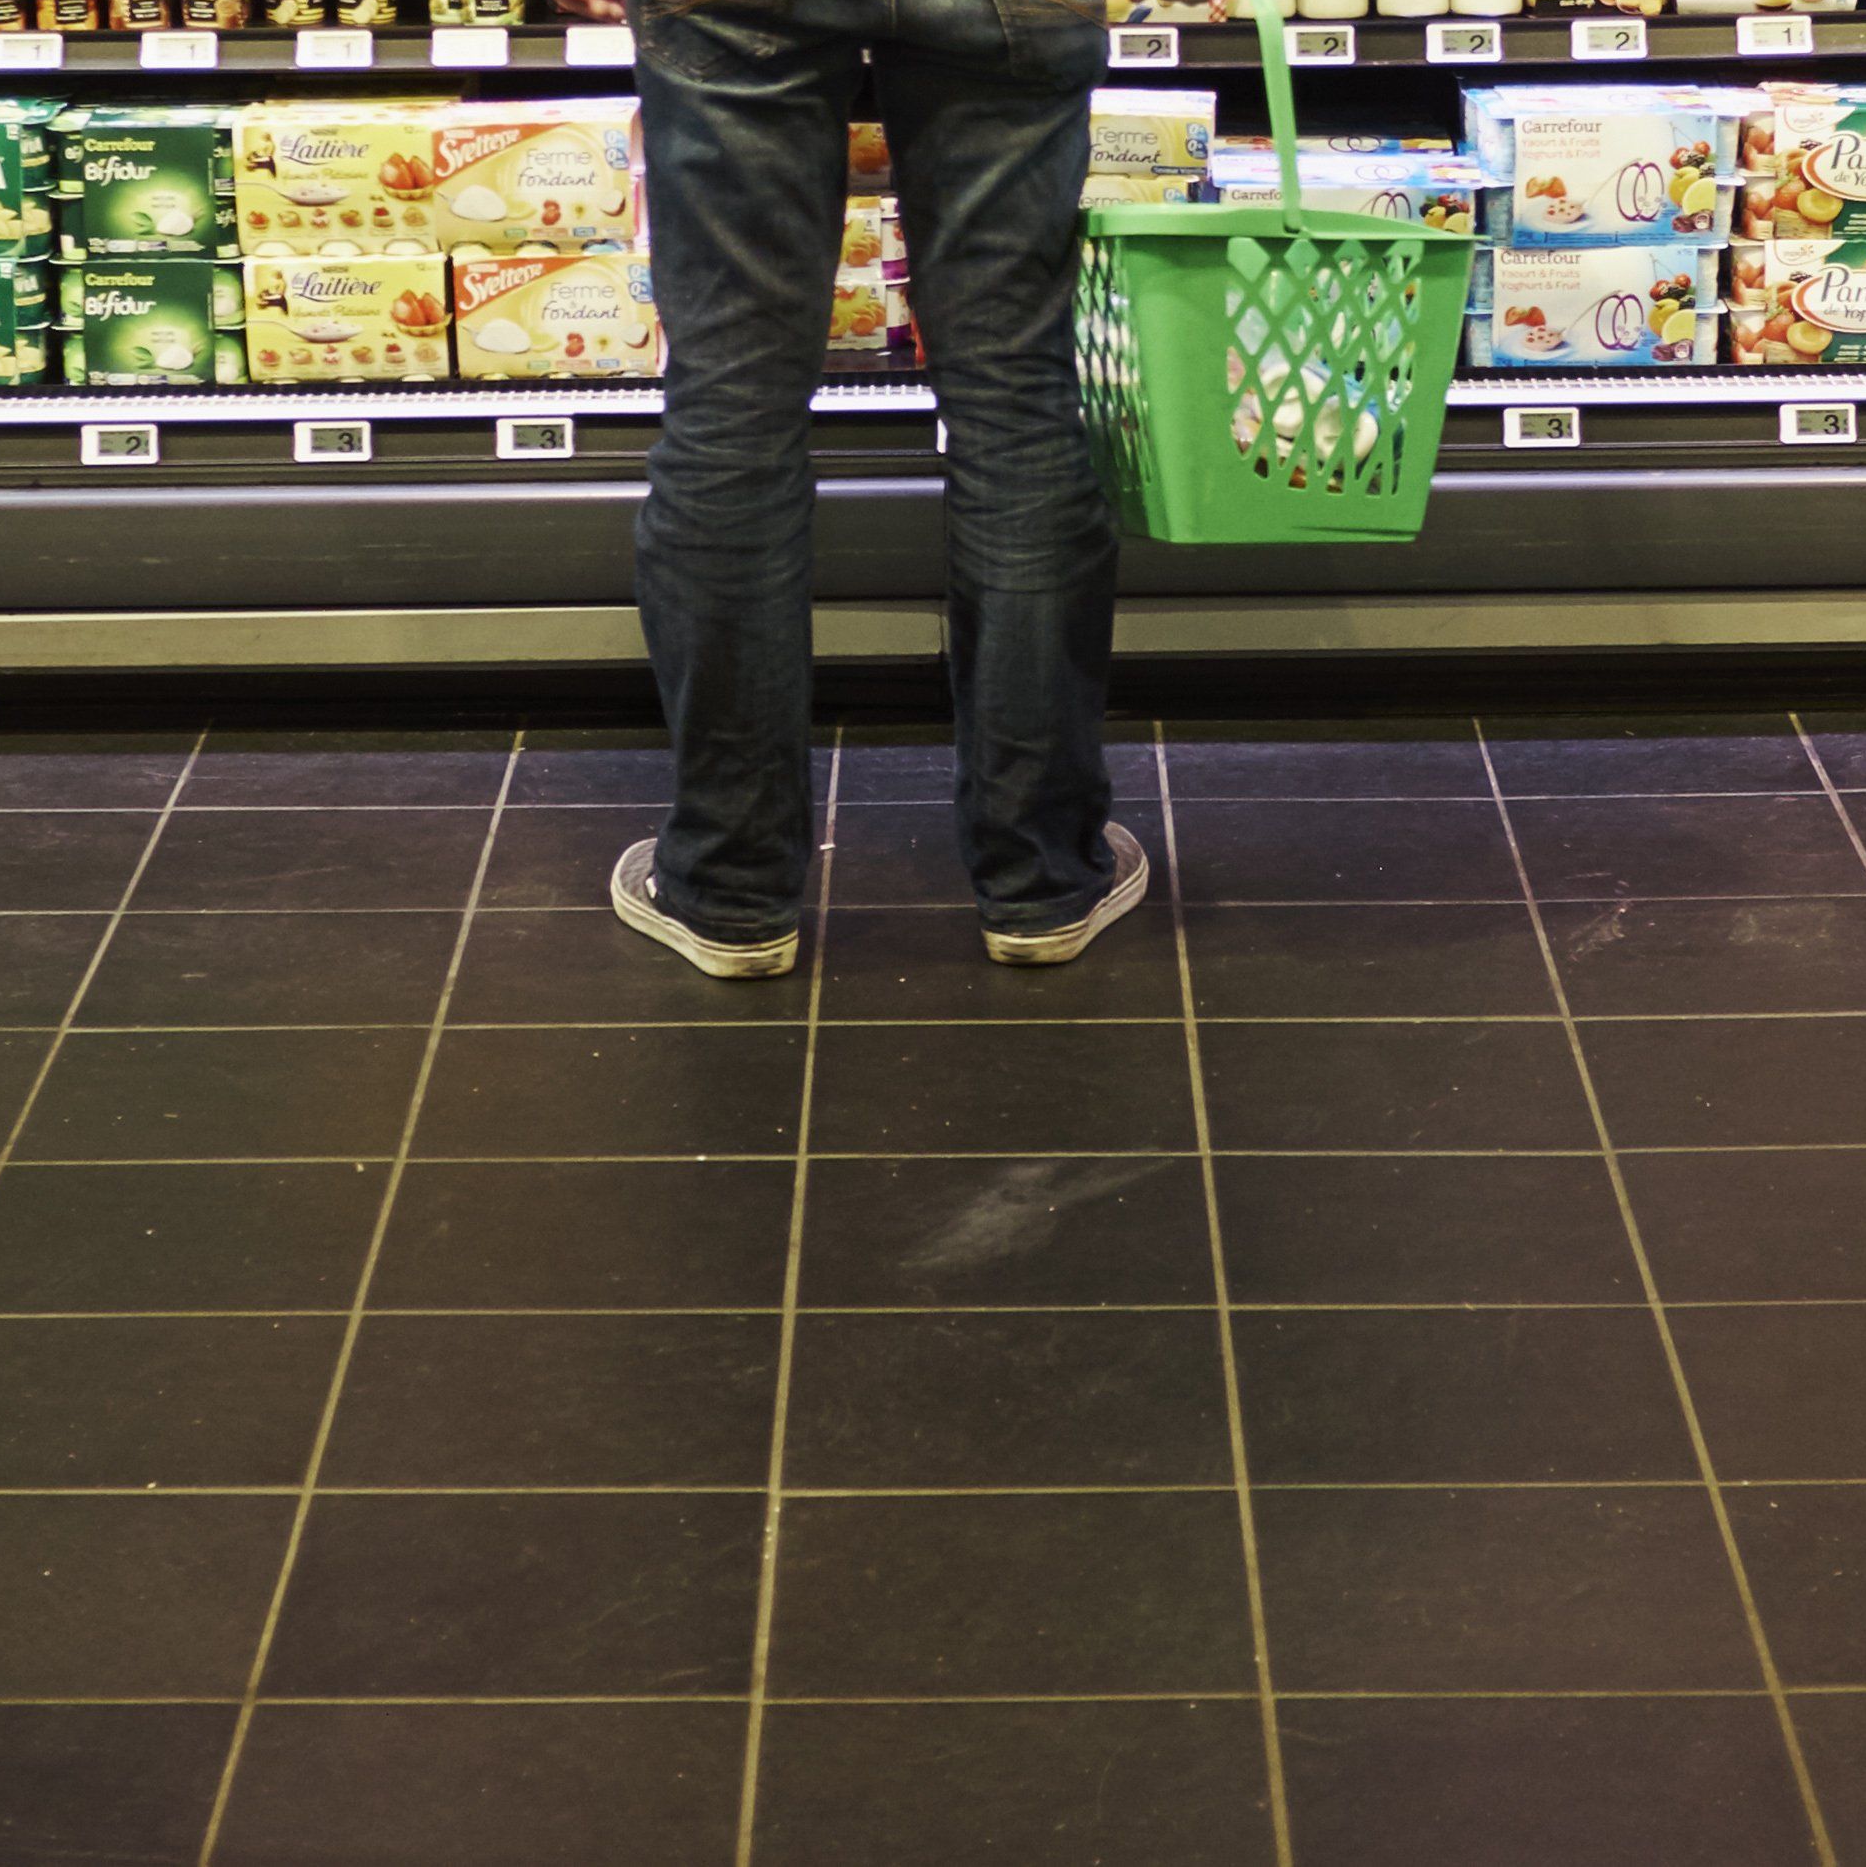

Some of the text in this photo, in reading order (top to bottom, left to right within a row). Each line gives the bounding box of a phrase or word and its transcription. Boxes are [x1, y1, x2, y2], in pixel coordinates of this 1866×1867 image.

[1147, 38, 1162, 59] 2
[1324, 36, 1339, 57] 2
[1469, 34, 1486, 54] 2
[1615, 31, 1631, 52] 2
[1096, 125, 1158, 145] Ferme
[1522, 118, 1602, 134] Carrefour
[84, 138, 155, 153] Carrefour
[283, 133, 371, 165] Laitière
[526, 149, 591, 166] Ferme
[517, 167, 600, 188] fondant
[1834, 173, 1849, 184] de
[1500, 250, 1581, 265] Carrefour
[85, 273, 154, 286] Carrefour
[293, 269, 382, 303] Laitière
[550, 282, 615, 299] Ferme
[541, 302, 622, 322] fondant
[1823, 305, 1840, 316] de
